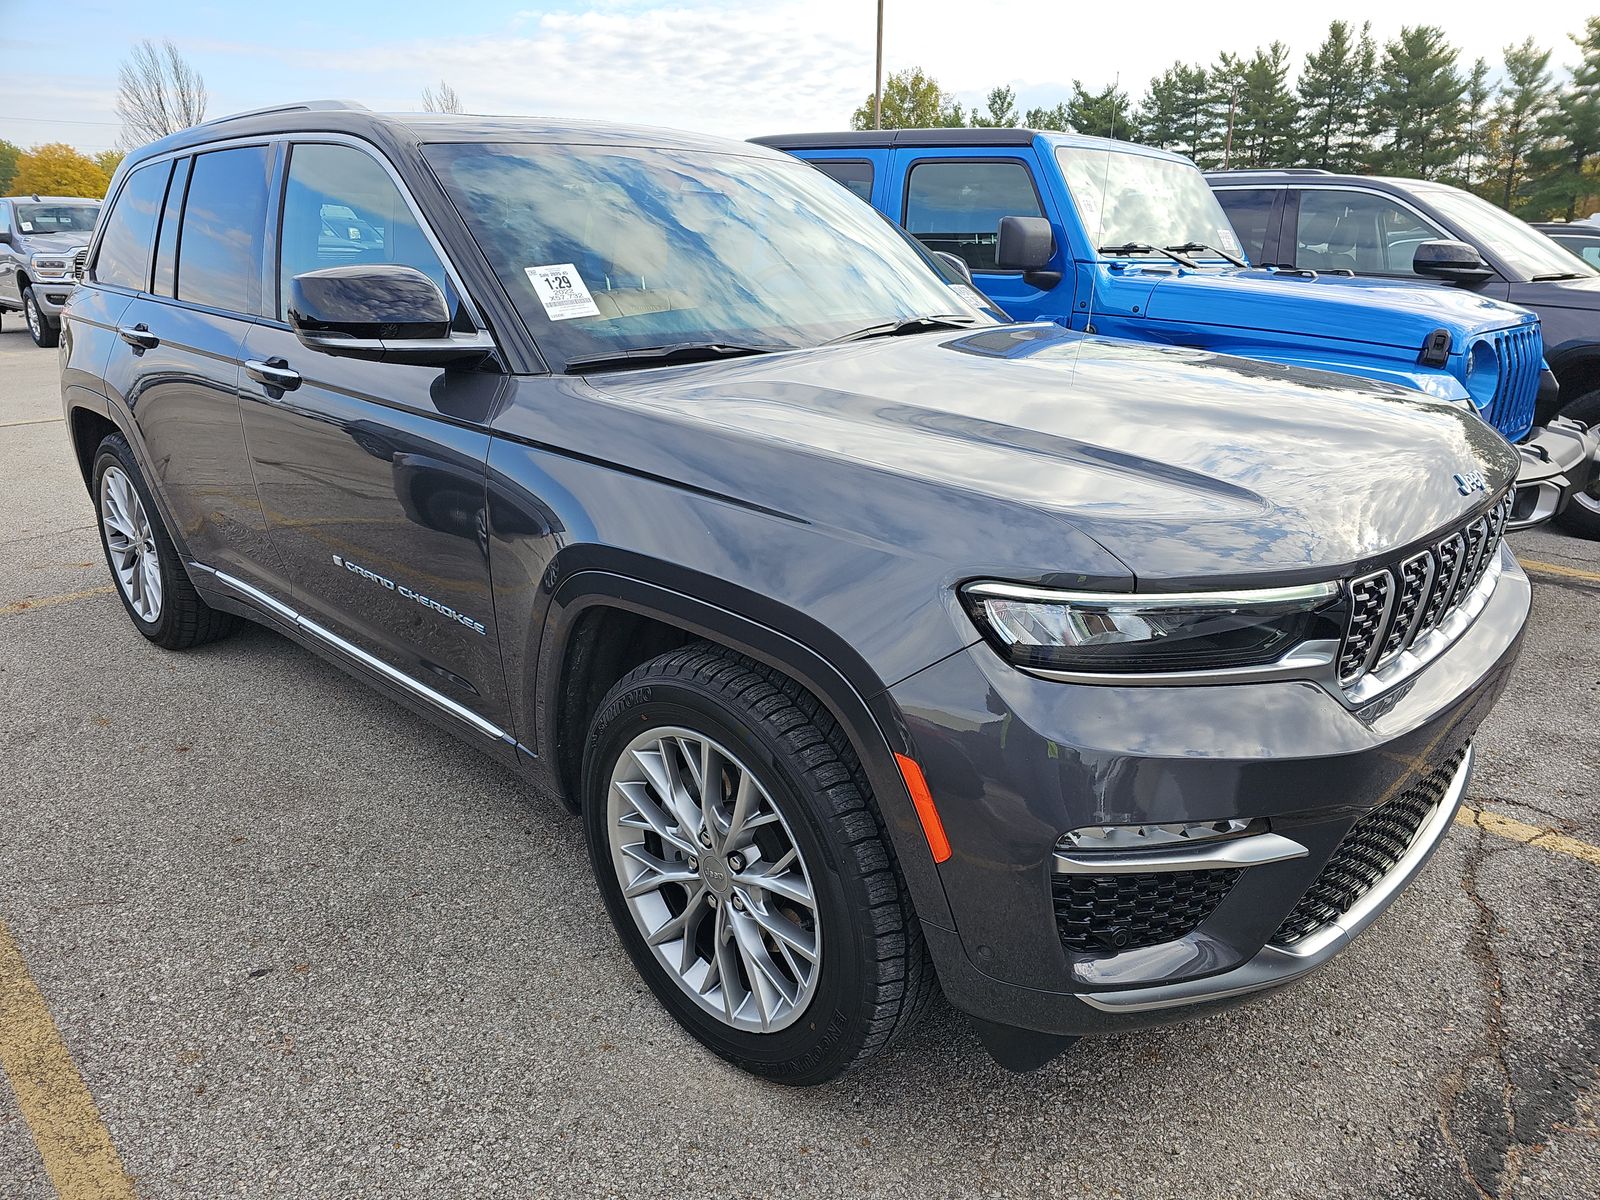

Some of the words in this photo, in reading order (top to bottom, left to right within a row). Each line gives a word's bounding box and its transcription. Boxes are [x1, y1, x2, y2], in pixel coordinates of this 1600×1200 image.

[544, 275, 572, 290] 1:29
[1453, 470, 1486, 496] Jeep
[344, 561, 396, 591] GRAND
[397, 585, 487, 635] CHEROKEE
[704, 867, 724, 882] Jeep
